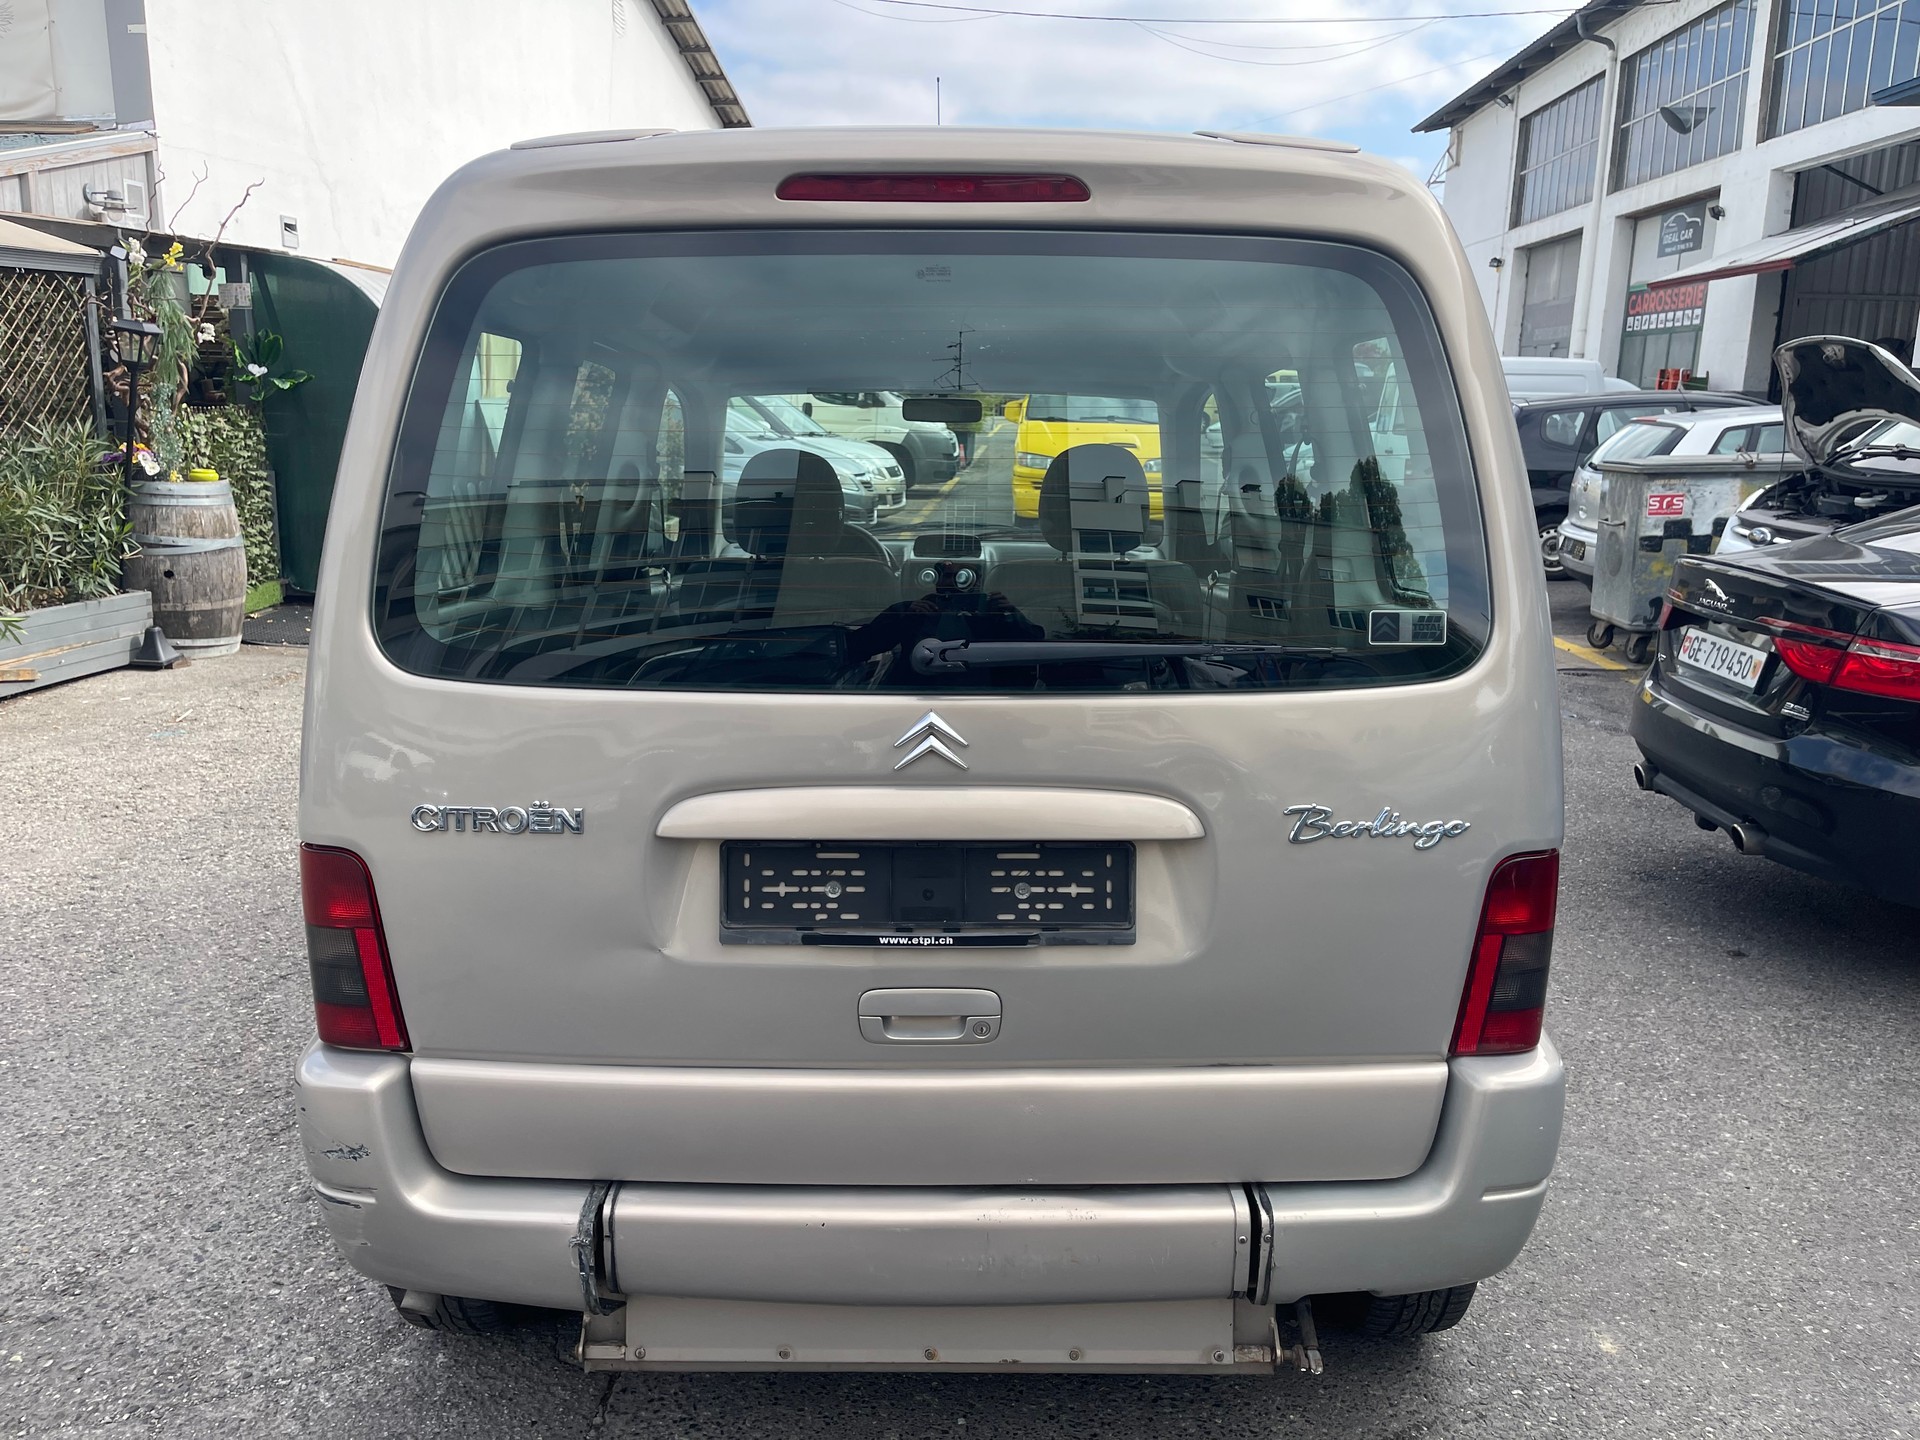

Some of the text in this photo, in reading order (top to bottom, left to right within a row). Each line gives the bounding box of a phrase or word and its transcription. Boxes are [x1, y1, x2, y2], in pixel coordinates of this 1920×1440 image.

[1680, 229, 1693, 241] CAR
[1628, 283, 1706, 315] CARROSSERIE
[1697, 597, 1728, 610] JAGUAR
[1412, 623, 1442, 632] TOTAL
[411, 800, 584, 834] CITROËN
[1283, 803, 1471, 850] Berlingo
[879, 936, 953, 946] www.etpl.ch
